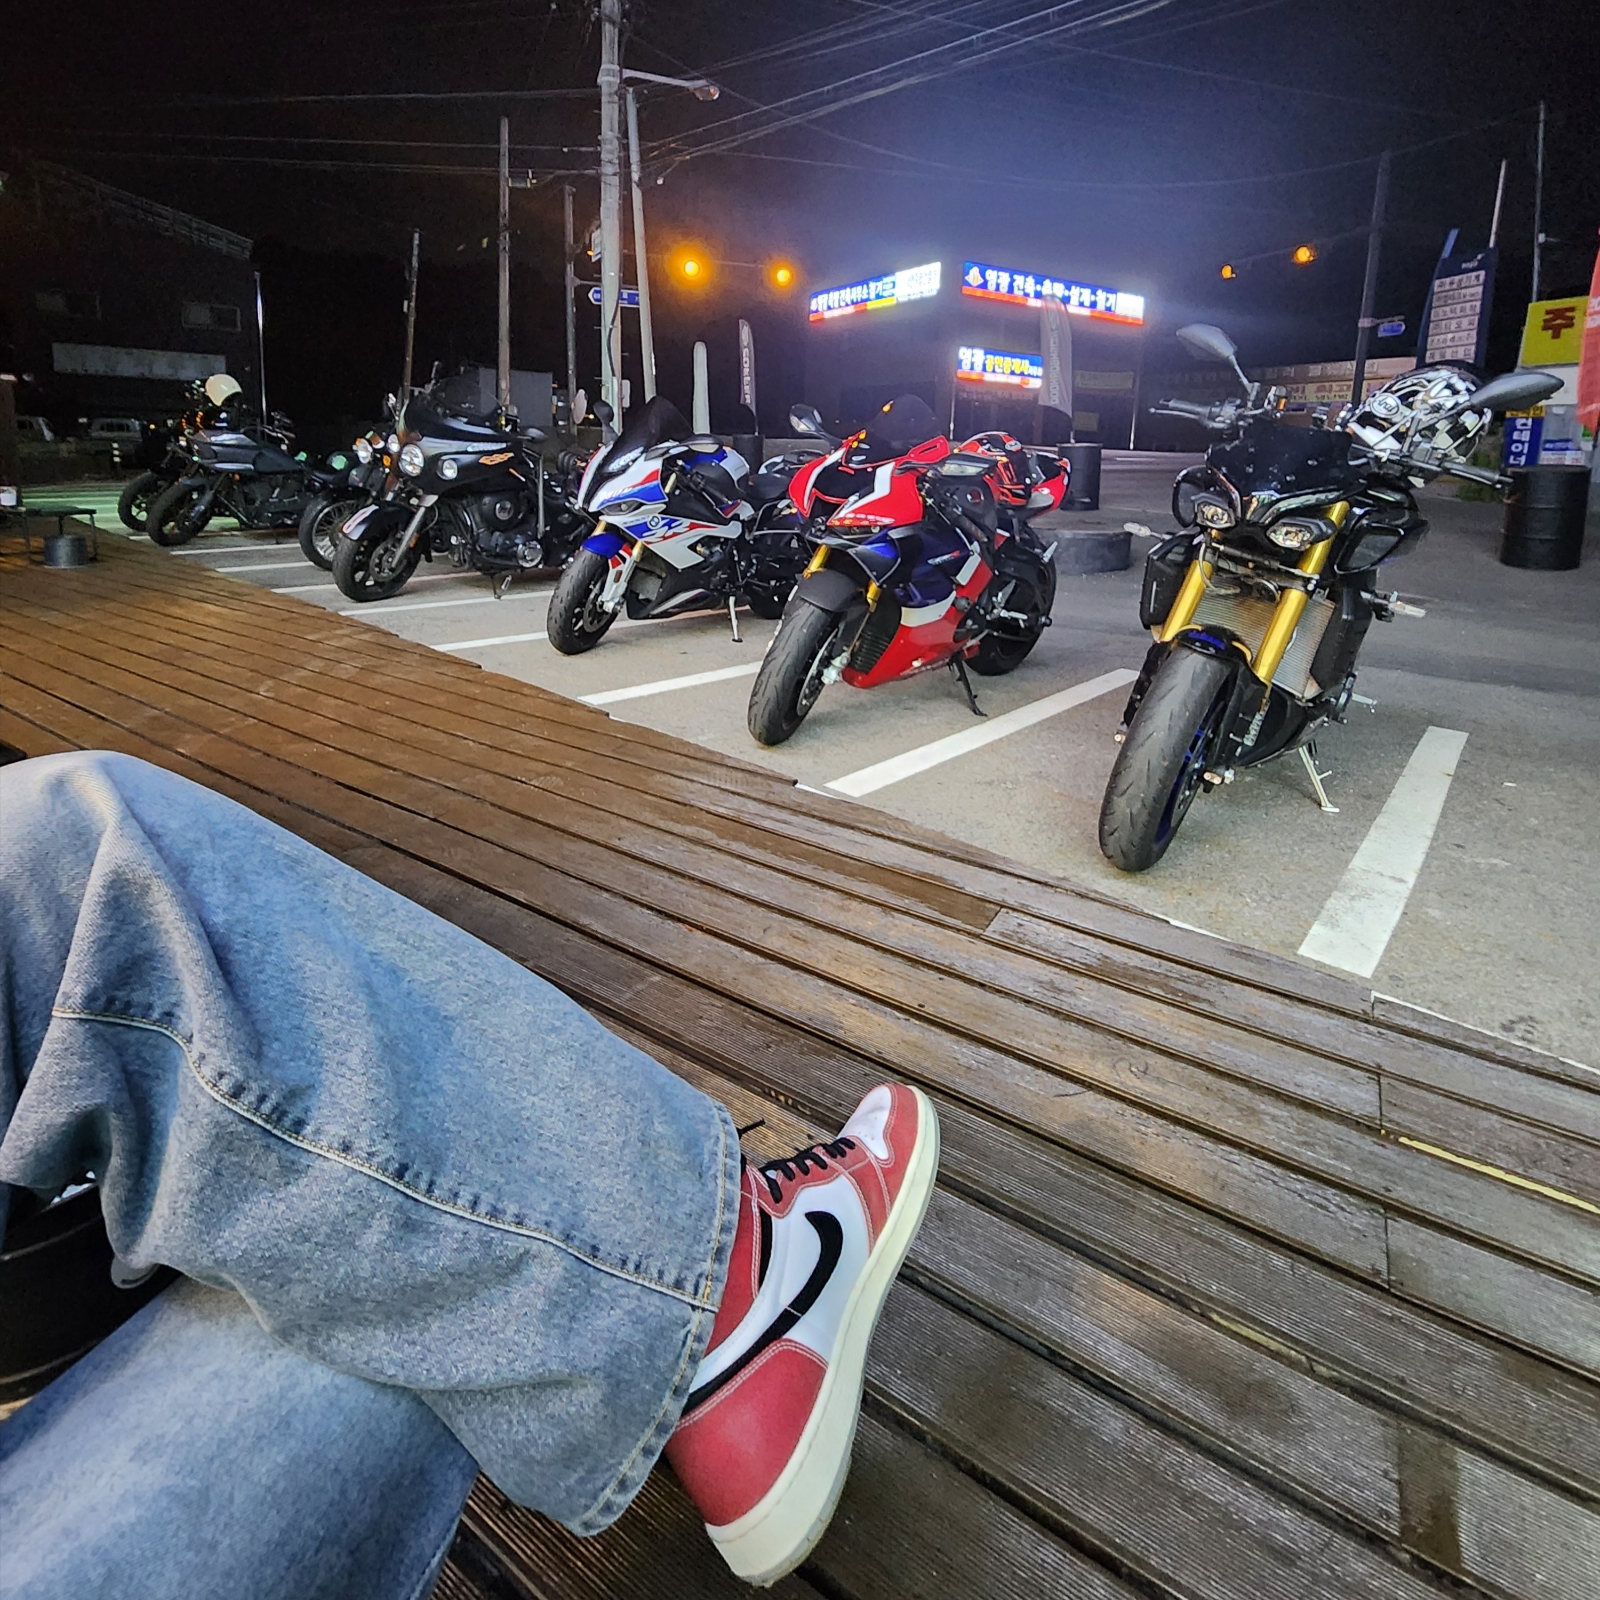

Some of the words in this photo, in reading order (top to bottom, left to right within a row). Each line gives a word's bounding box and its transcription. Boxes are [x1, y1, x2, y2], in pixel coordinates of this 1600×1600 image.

[985, 269, 1010, 293] 영광
[959, 346, 985, 371] 영광
[985, 354, 1029, 375] 공인중개사
[1509, 418, 1533, 466] 컨테이너
